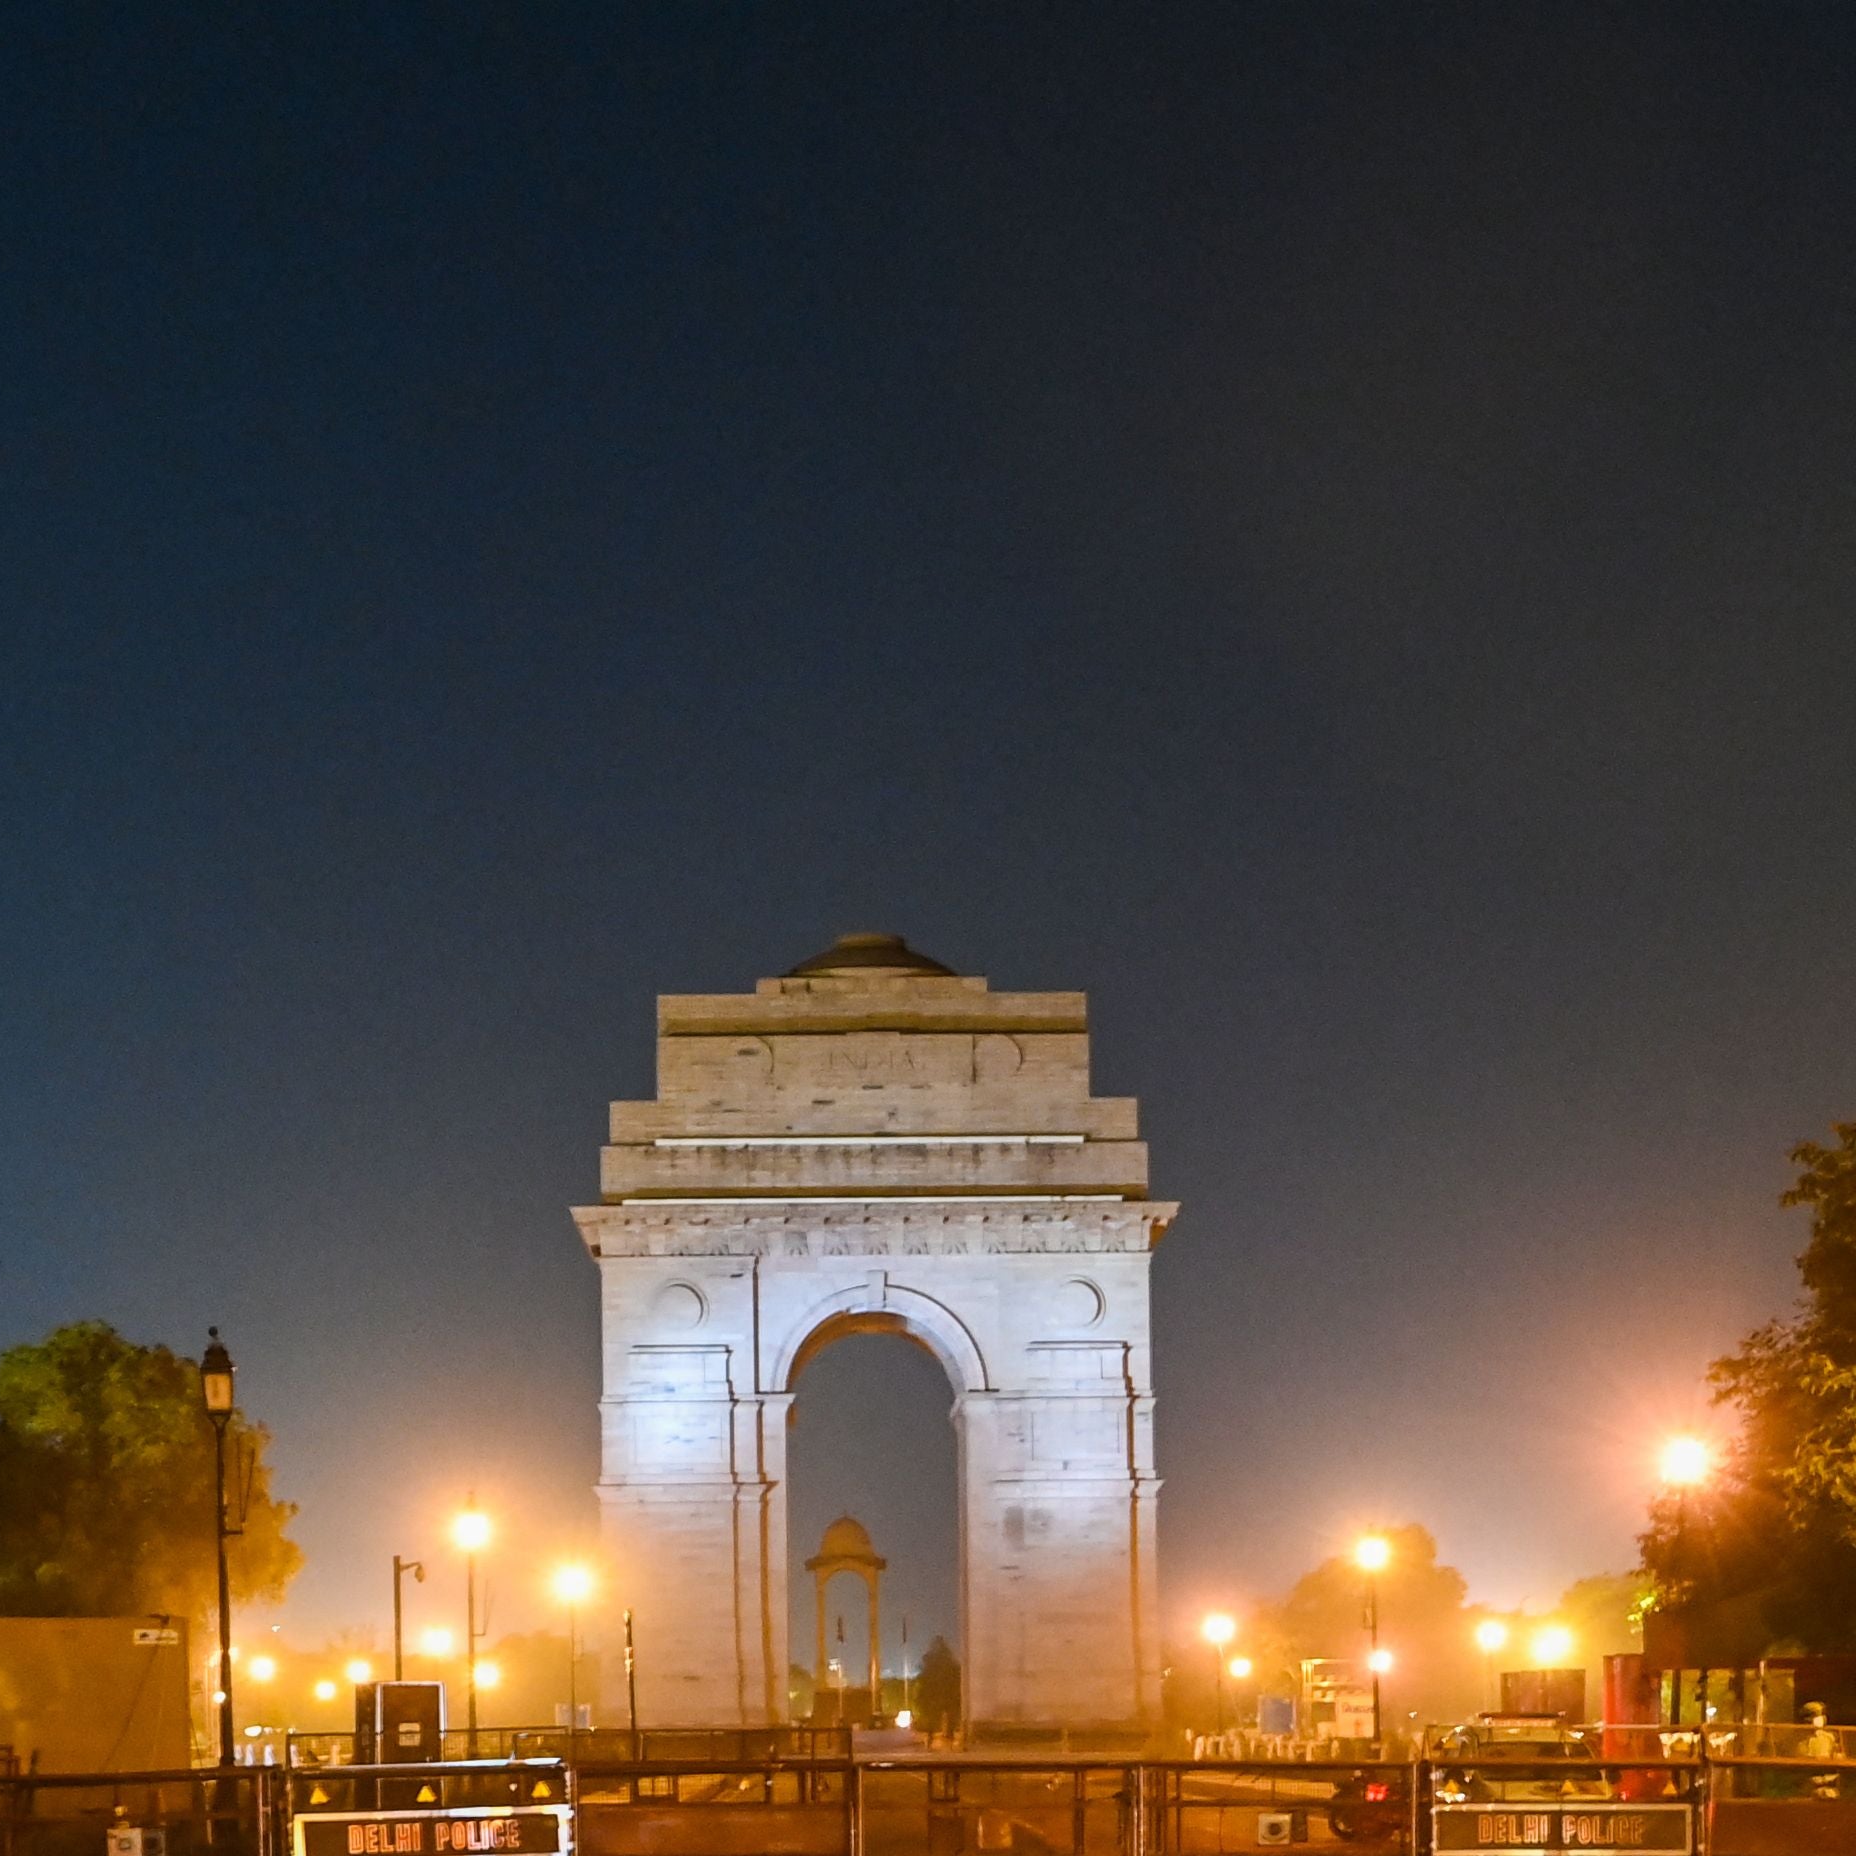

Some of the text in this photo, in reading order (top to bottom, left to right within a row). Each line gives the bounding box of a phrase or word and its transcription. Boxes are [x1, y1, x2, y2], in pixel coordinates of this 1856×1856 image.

[347, 1819, 521, 1855] DELHI POLICE
[1477, 1813, 1647, 1845] DELHI POLICE
